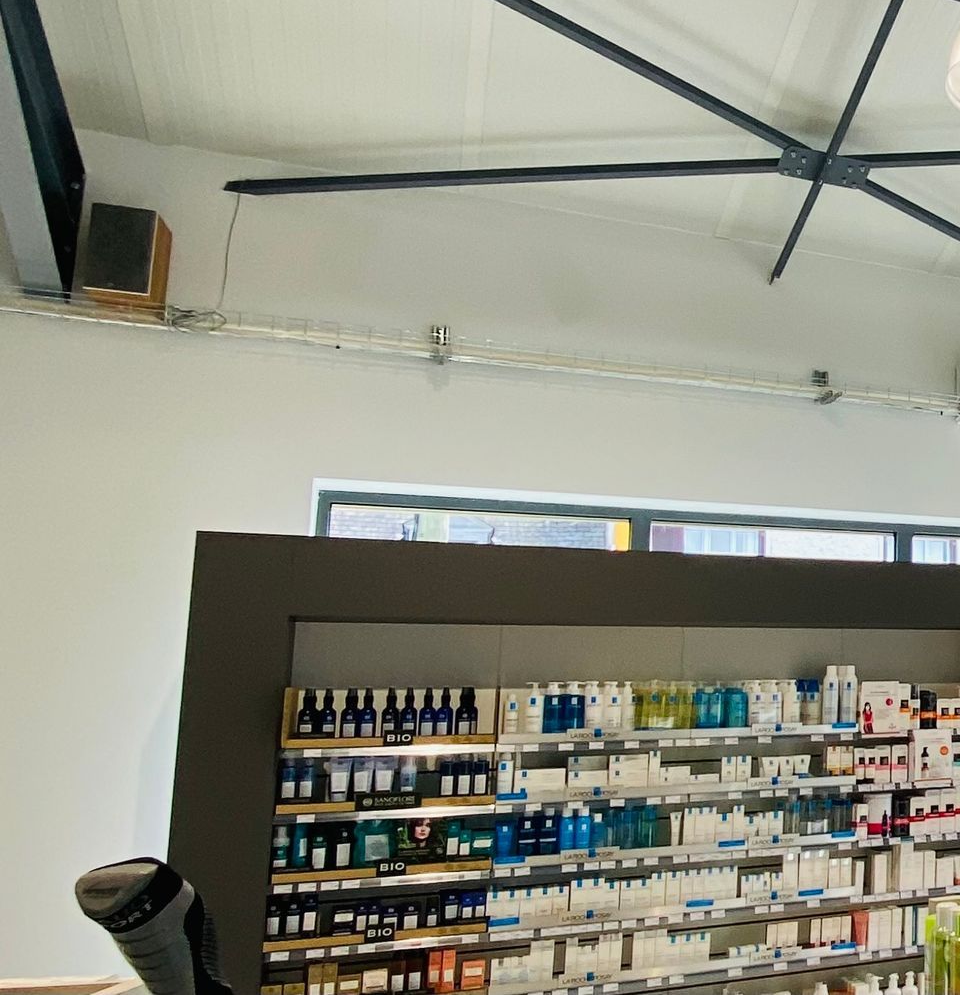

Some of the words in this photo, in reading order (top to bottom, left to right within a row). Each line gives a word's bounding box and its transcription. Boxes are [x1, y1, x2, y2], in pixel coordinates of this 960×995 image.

[386, 734, 412, 743] BIO
[379, 862, 405, 872] BIO
[367, 927, 393, 938] BIO
